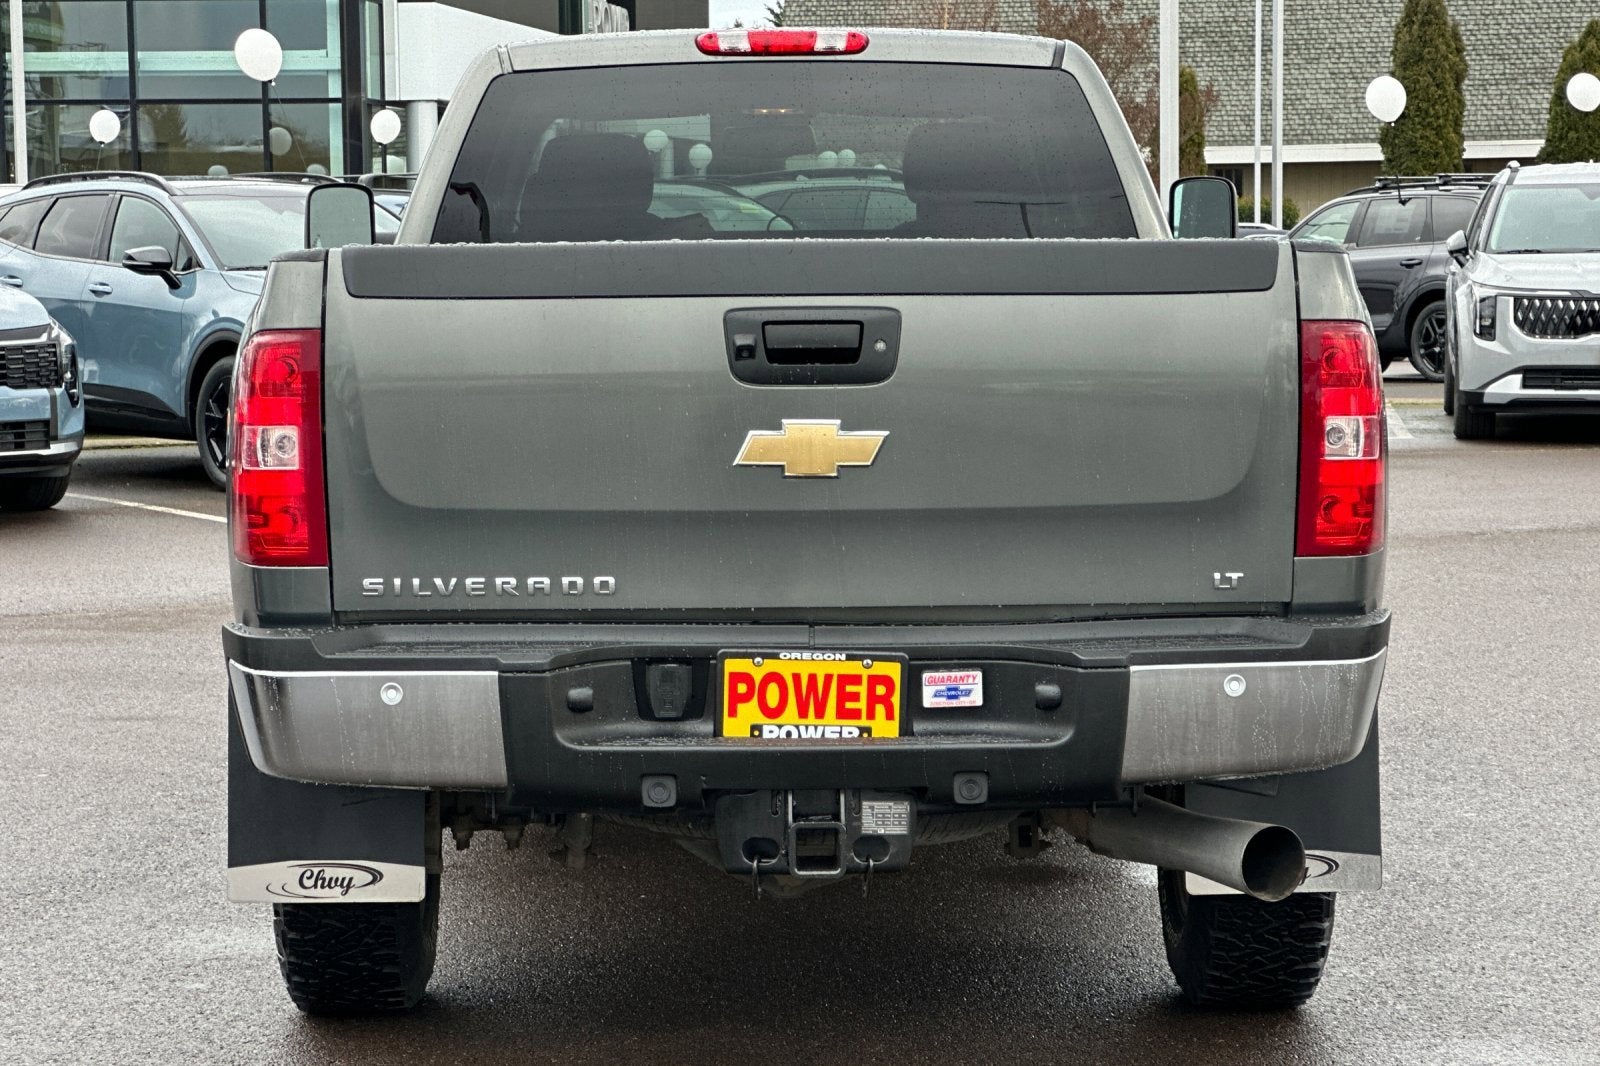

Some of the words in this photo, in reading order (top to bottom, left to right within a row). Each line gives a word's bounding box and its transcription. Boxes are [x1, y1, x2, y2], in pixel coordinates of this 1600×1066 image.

[362, 576, 616, 596] SILVERADO
[1213, 572, 1244, 588] LT
[779, 652, 846, 661] OREGON
[927, 674, 978, 685] GUARANTY
[727, 671, 896, 721] POWER
